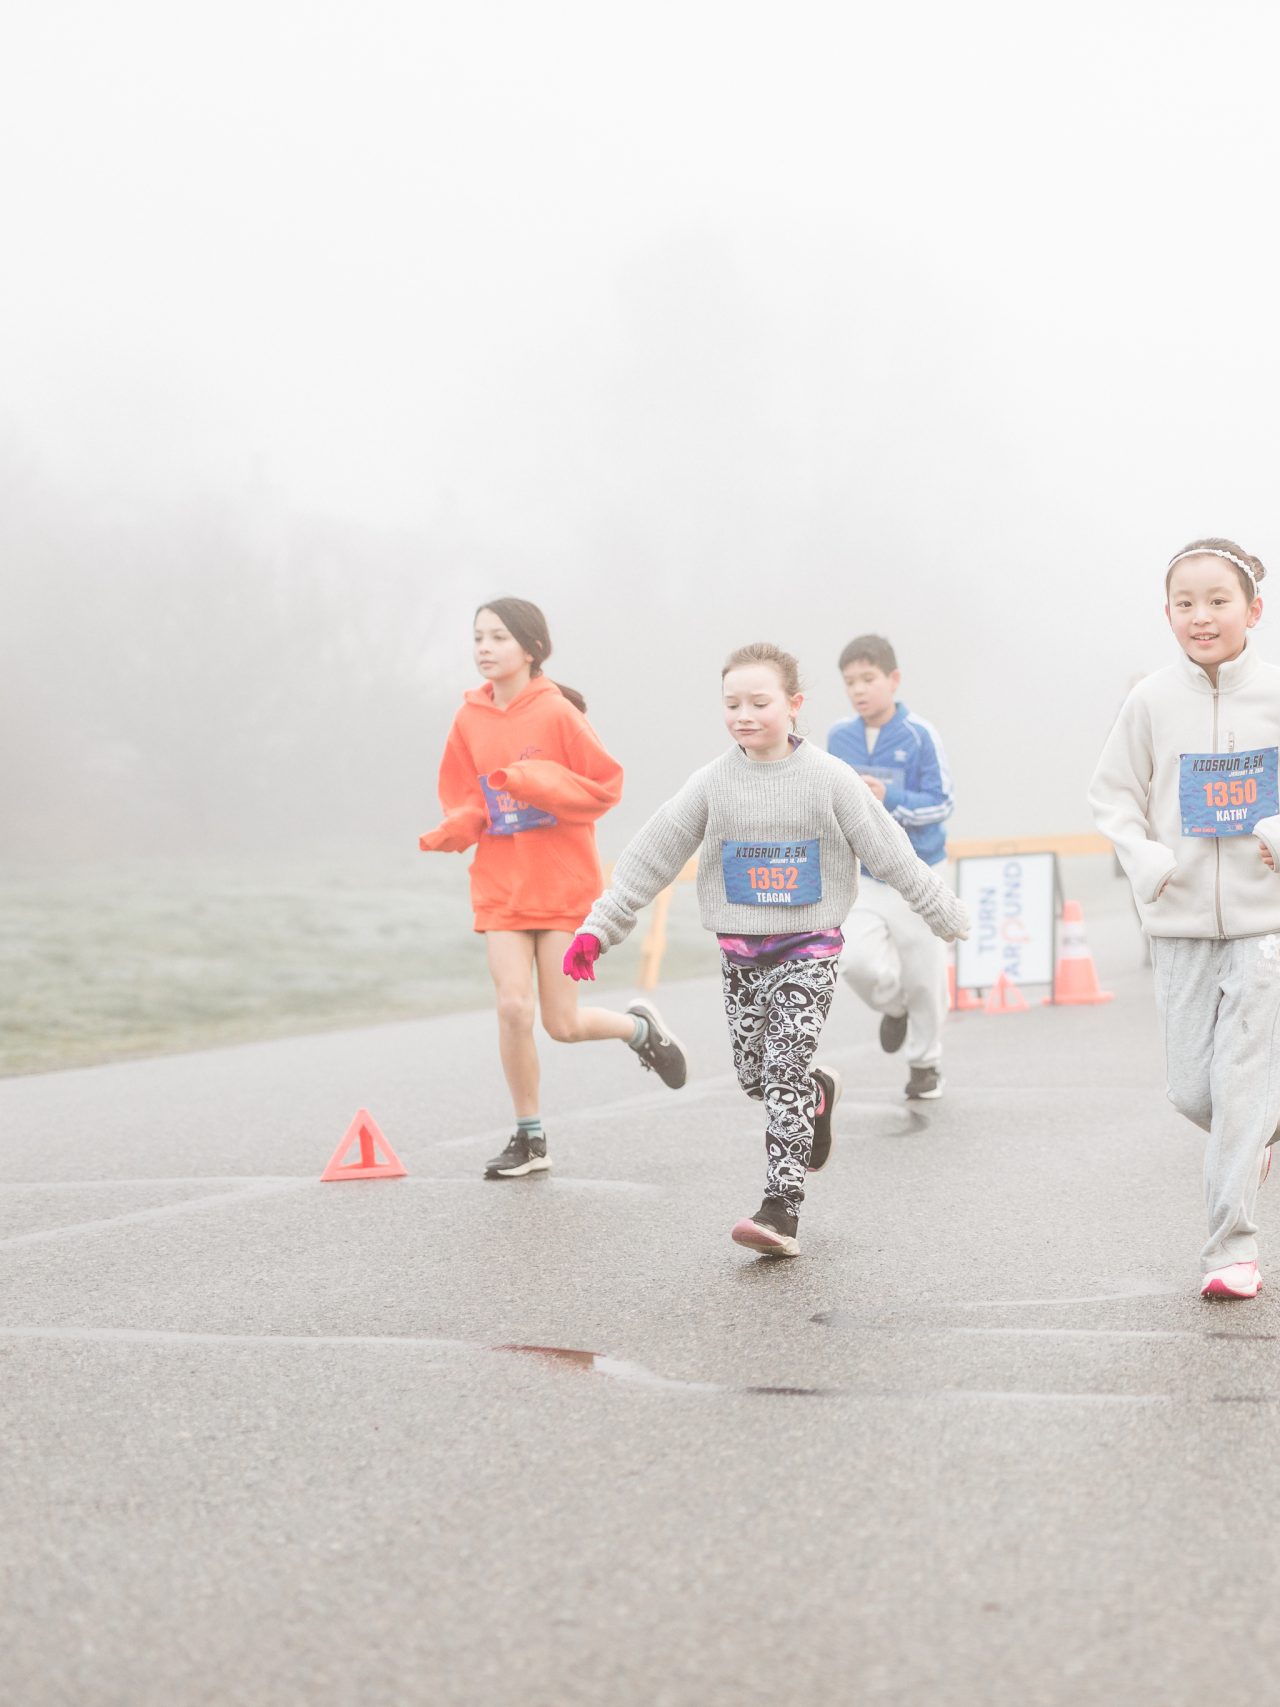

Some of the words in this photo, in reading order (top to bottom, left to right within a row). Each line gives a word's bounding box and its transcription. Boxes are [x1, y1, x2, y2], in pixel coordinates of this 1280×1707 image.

[1192, 757, 1240, 772] KIDSRUN
[1244, 754, 1264, 769] 2.5K
[1202, 778, 1257, 807] 1350
[1216, 807, 1248, 822] KATHY
[736, 847, 781, 858] KIDSRUN
[784, 846, 807, 858] 2.5K
[746, 866, 800, 890] 1352
[756, 892, 791, 903] TEAGAN
[978, 886, 997, 954] TURN
